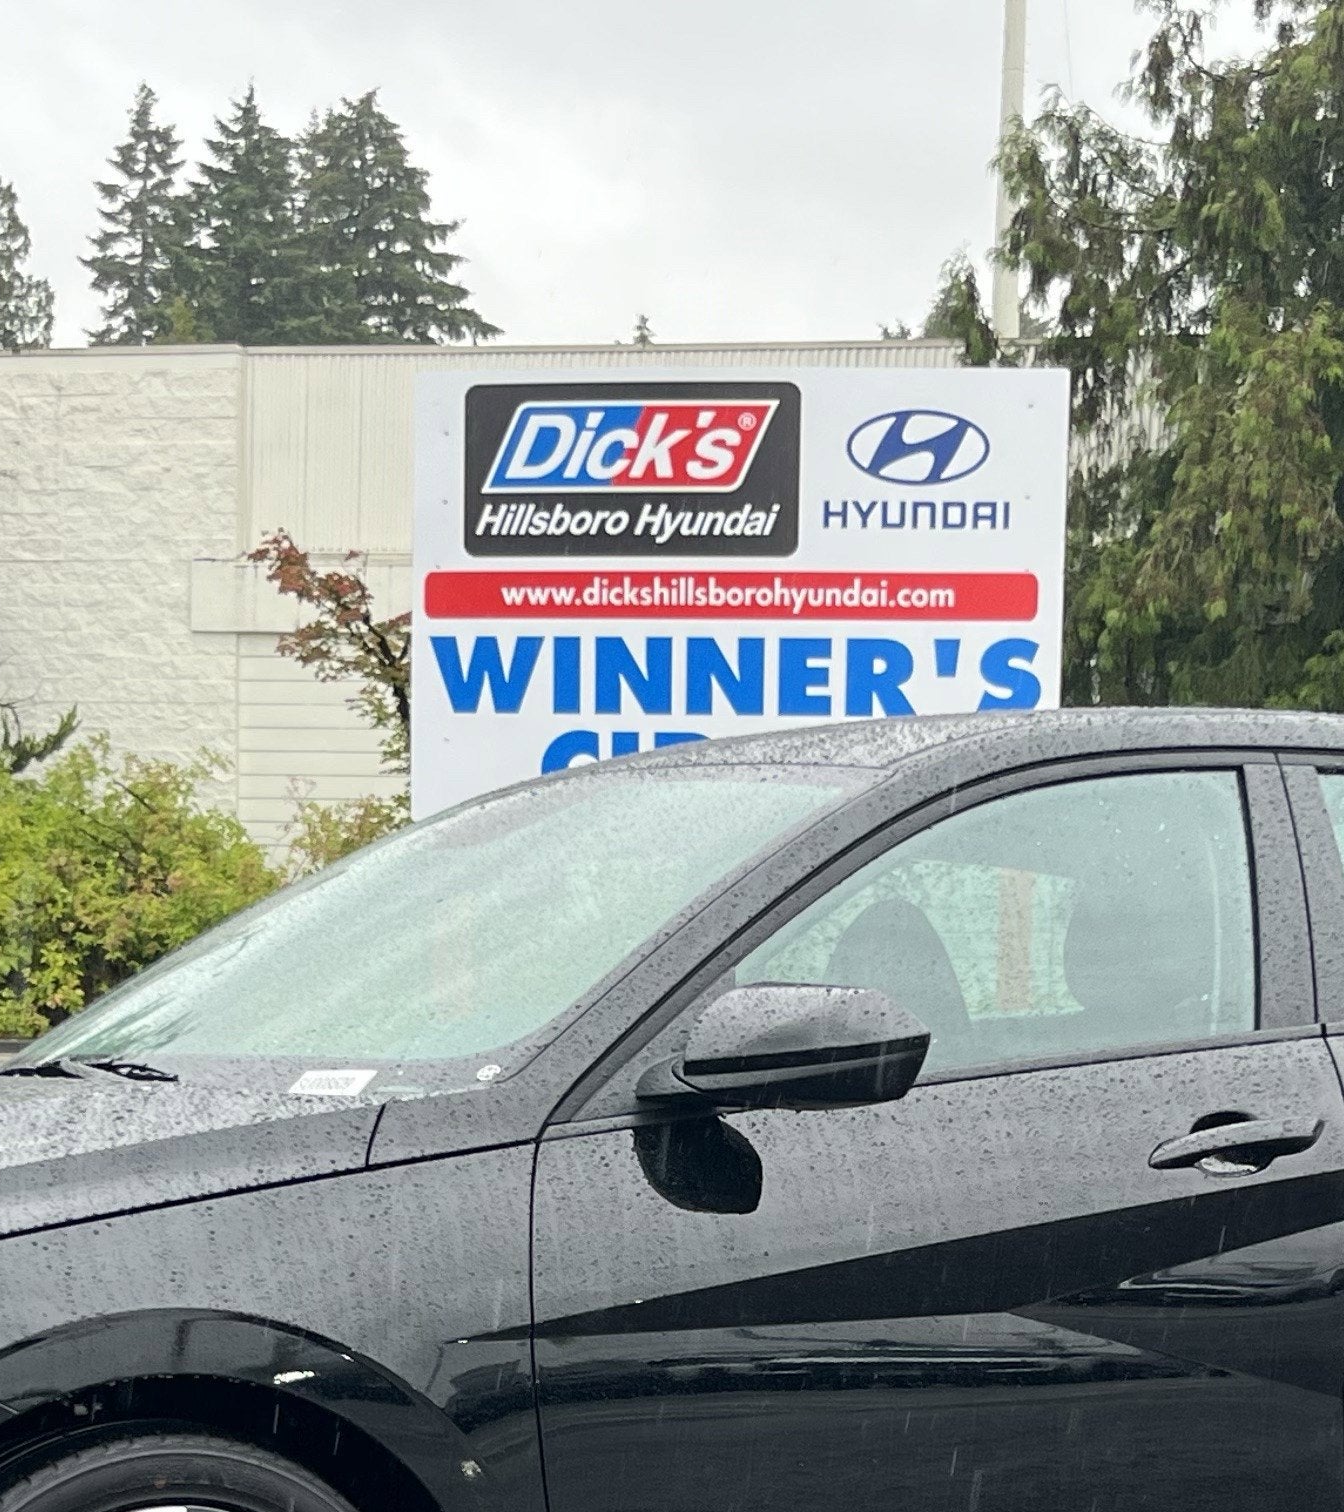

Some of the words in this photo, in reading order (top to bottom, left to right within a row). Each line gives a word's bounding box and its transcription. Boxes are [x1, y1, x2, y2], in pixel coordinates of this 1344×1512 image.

[475, 503, 629, 536] Hillsboro
[633, 503, 780, 544] Hyundai
[823, 500, 1010, 530] HYUNDAI
[501, 577, 955, 615] www.dickshillsborohyundai.com
[430, 636, 1042, 717] WINNER'S
